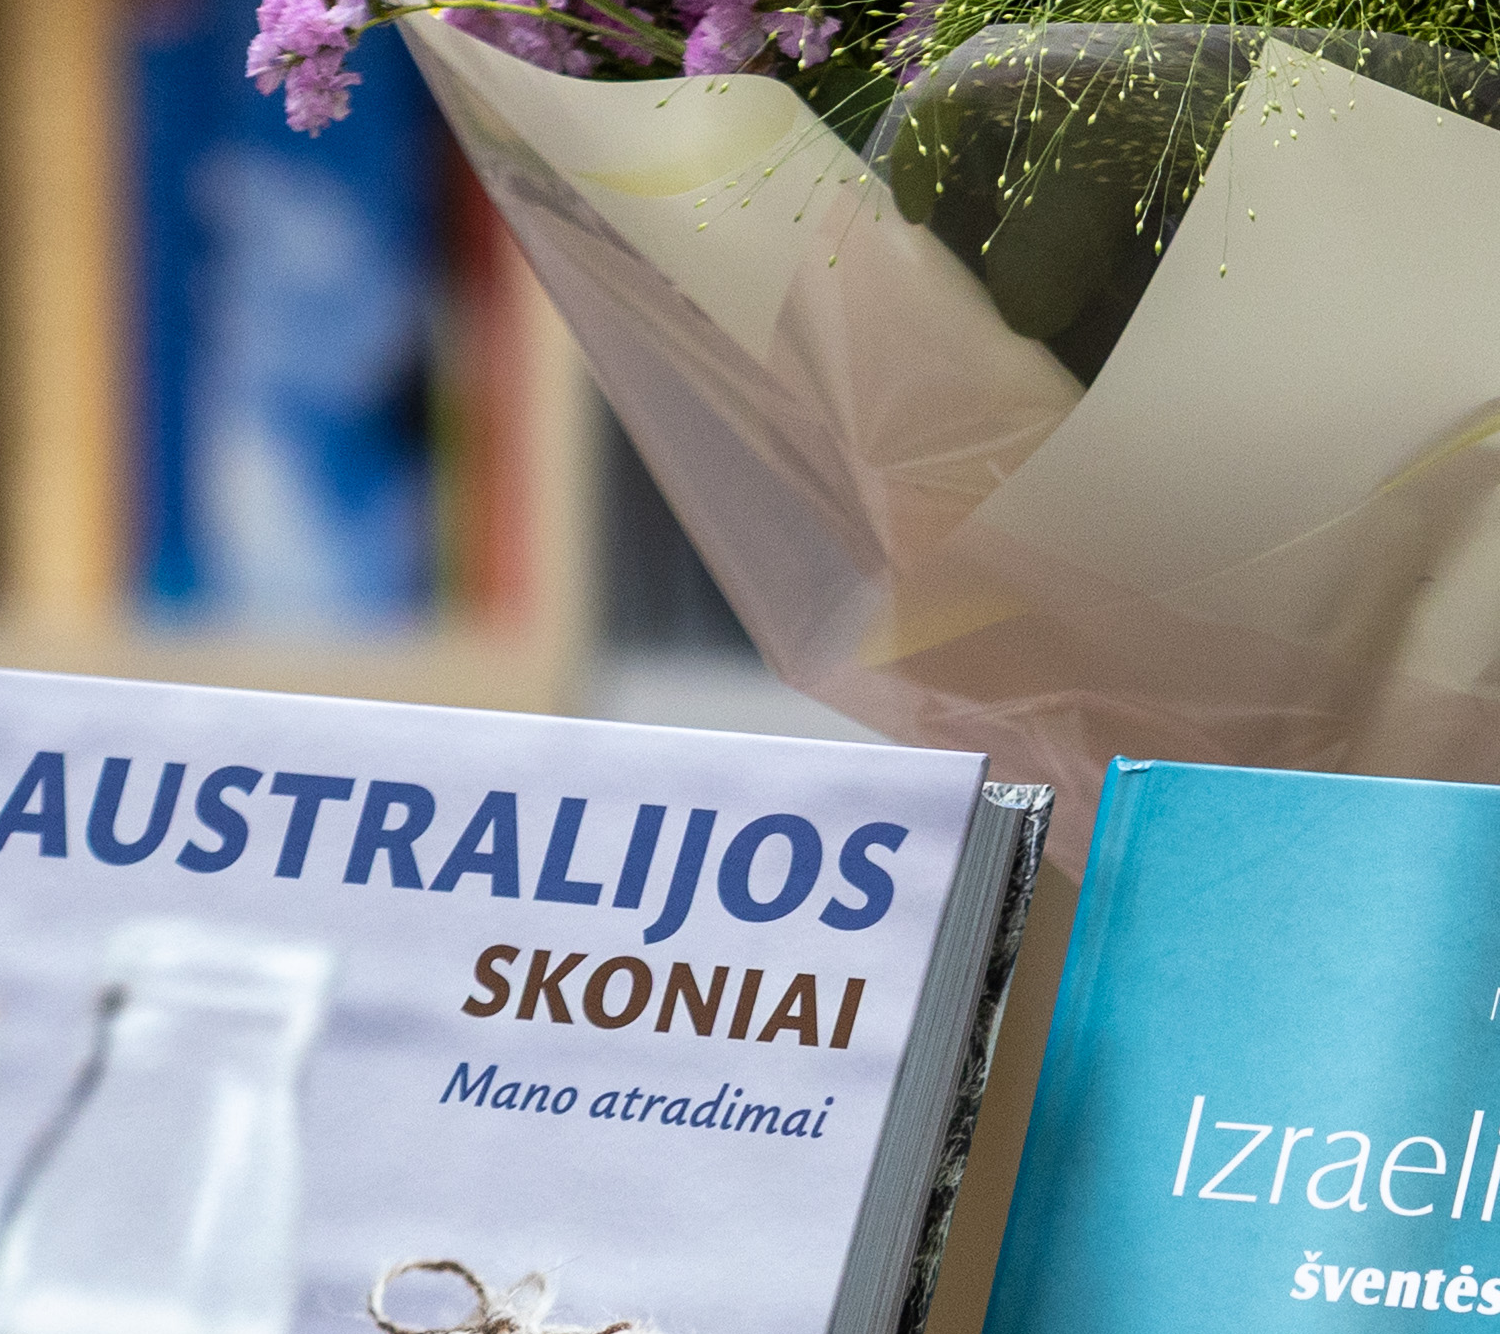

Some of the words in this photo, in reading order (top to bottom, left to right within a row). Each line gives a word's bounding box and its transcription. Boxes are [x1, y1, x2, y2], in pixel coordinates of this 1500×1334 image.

[461, 943, 867, 1050] SKONIAI
[439, 1062, 578, 1115] Mano
[589, 1083, 834, 1139] atradimai
